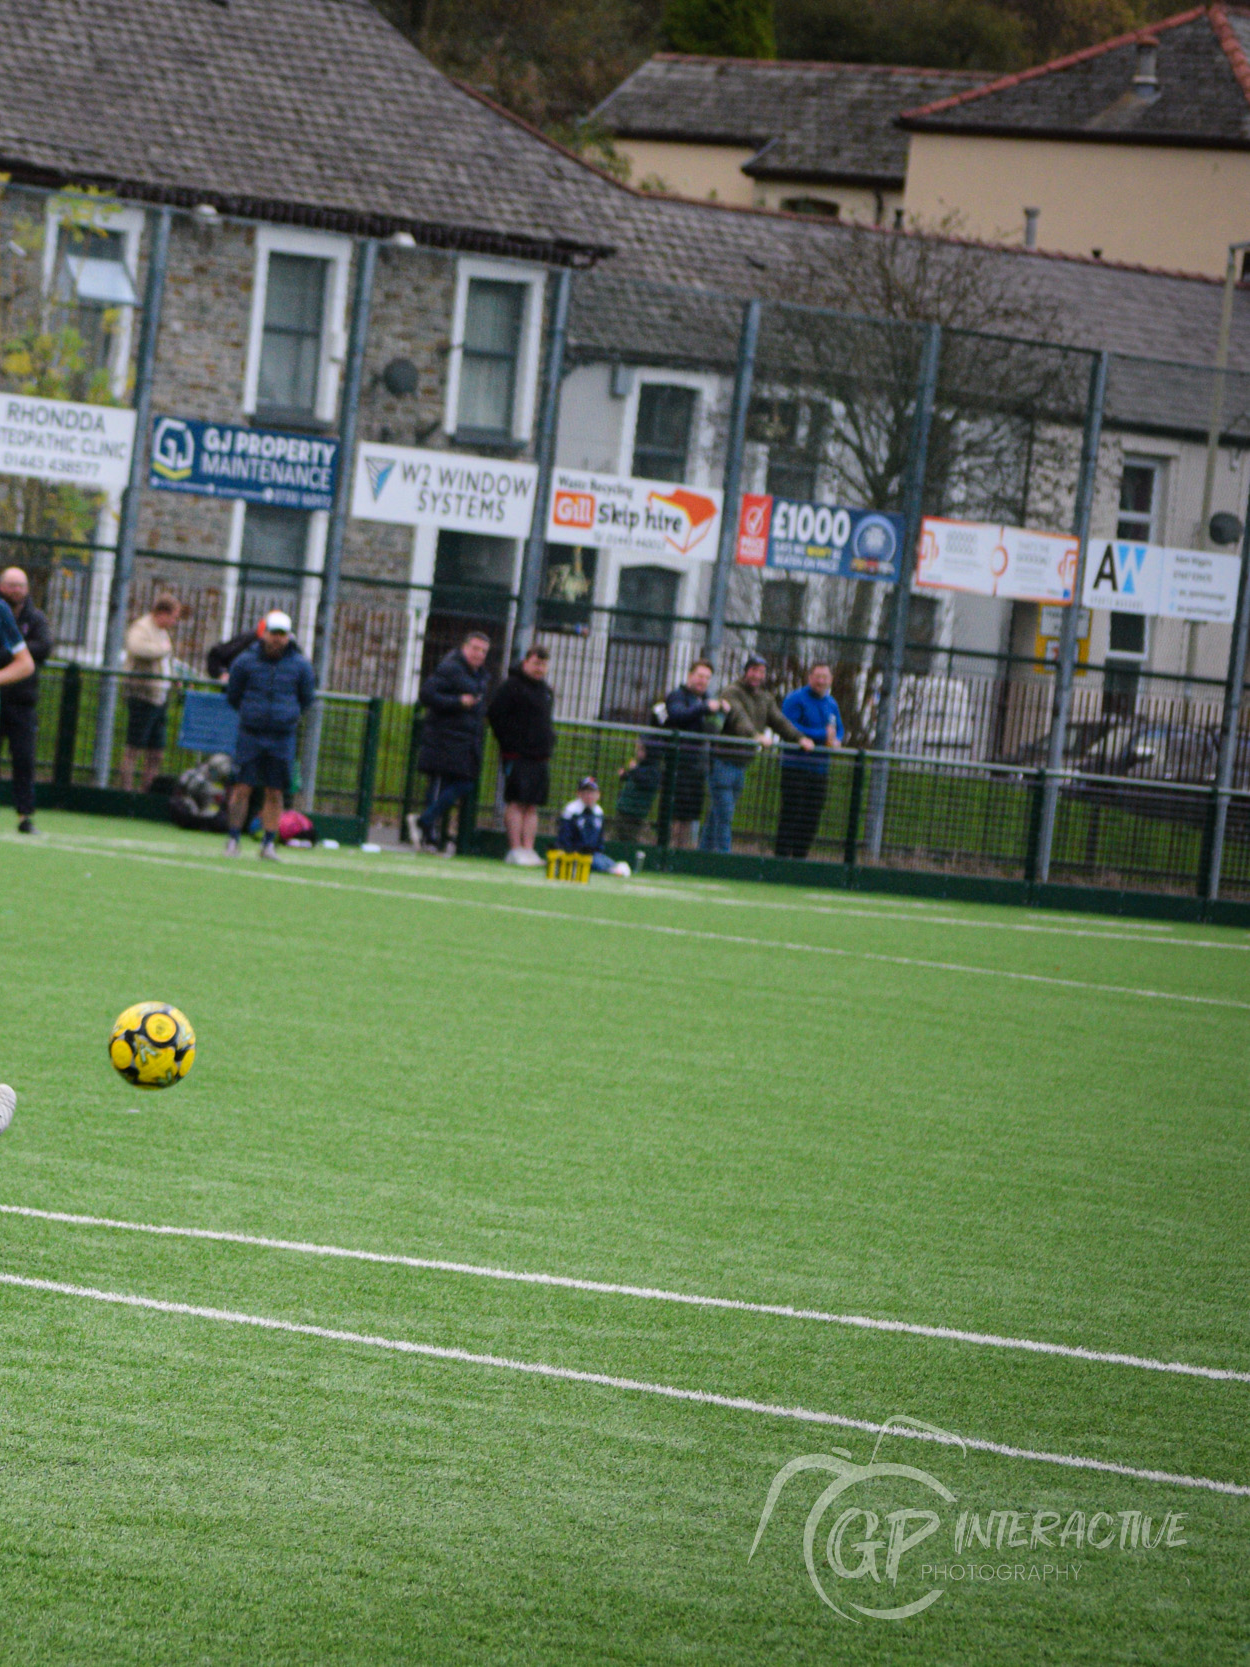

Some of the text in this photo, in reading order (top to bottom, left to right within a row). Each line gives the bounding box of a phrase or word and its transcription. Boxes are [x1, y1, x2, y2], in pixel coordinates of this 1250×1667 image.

[6, 401, 106, 434] RHONDDA
[81, 437, 128, 460] CLINIC
[203, 427, 336, 466] GJ PROPERTY
[201, 451, 332, 492] MAINTENANCE
[402, 460, 532, 499] W2 WINDOW
[417, 489, 505, 521] SYSTEMS
[556, 496, 682, 533] Gill Skip hire
[772, 501, 851, 547] £1000
[1093, 543, 1147, 593] AW
